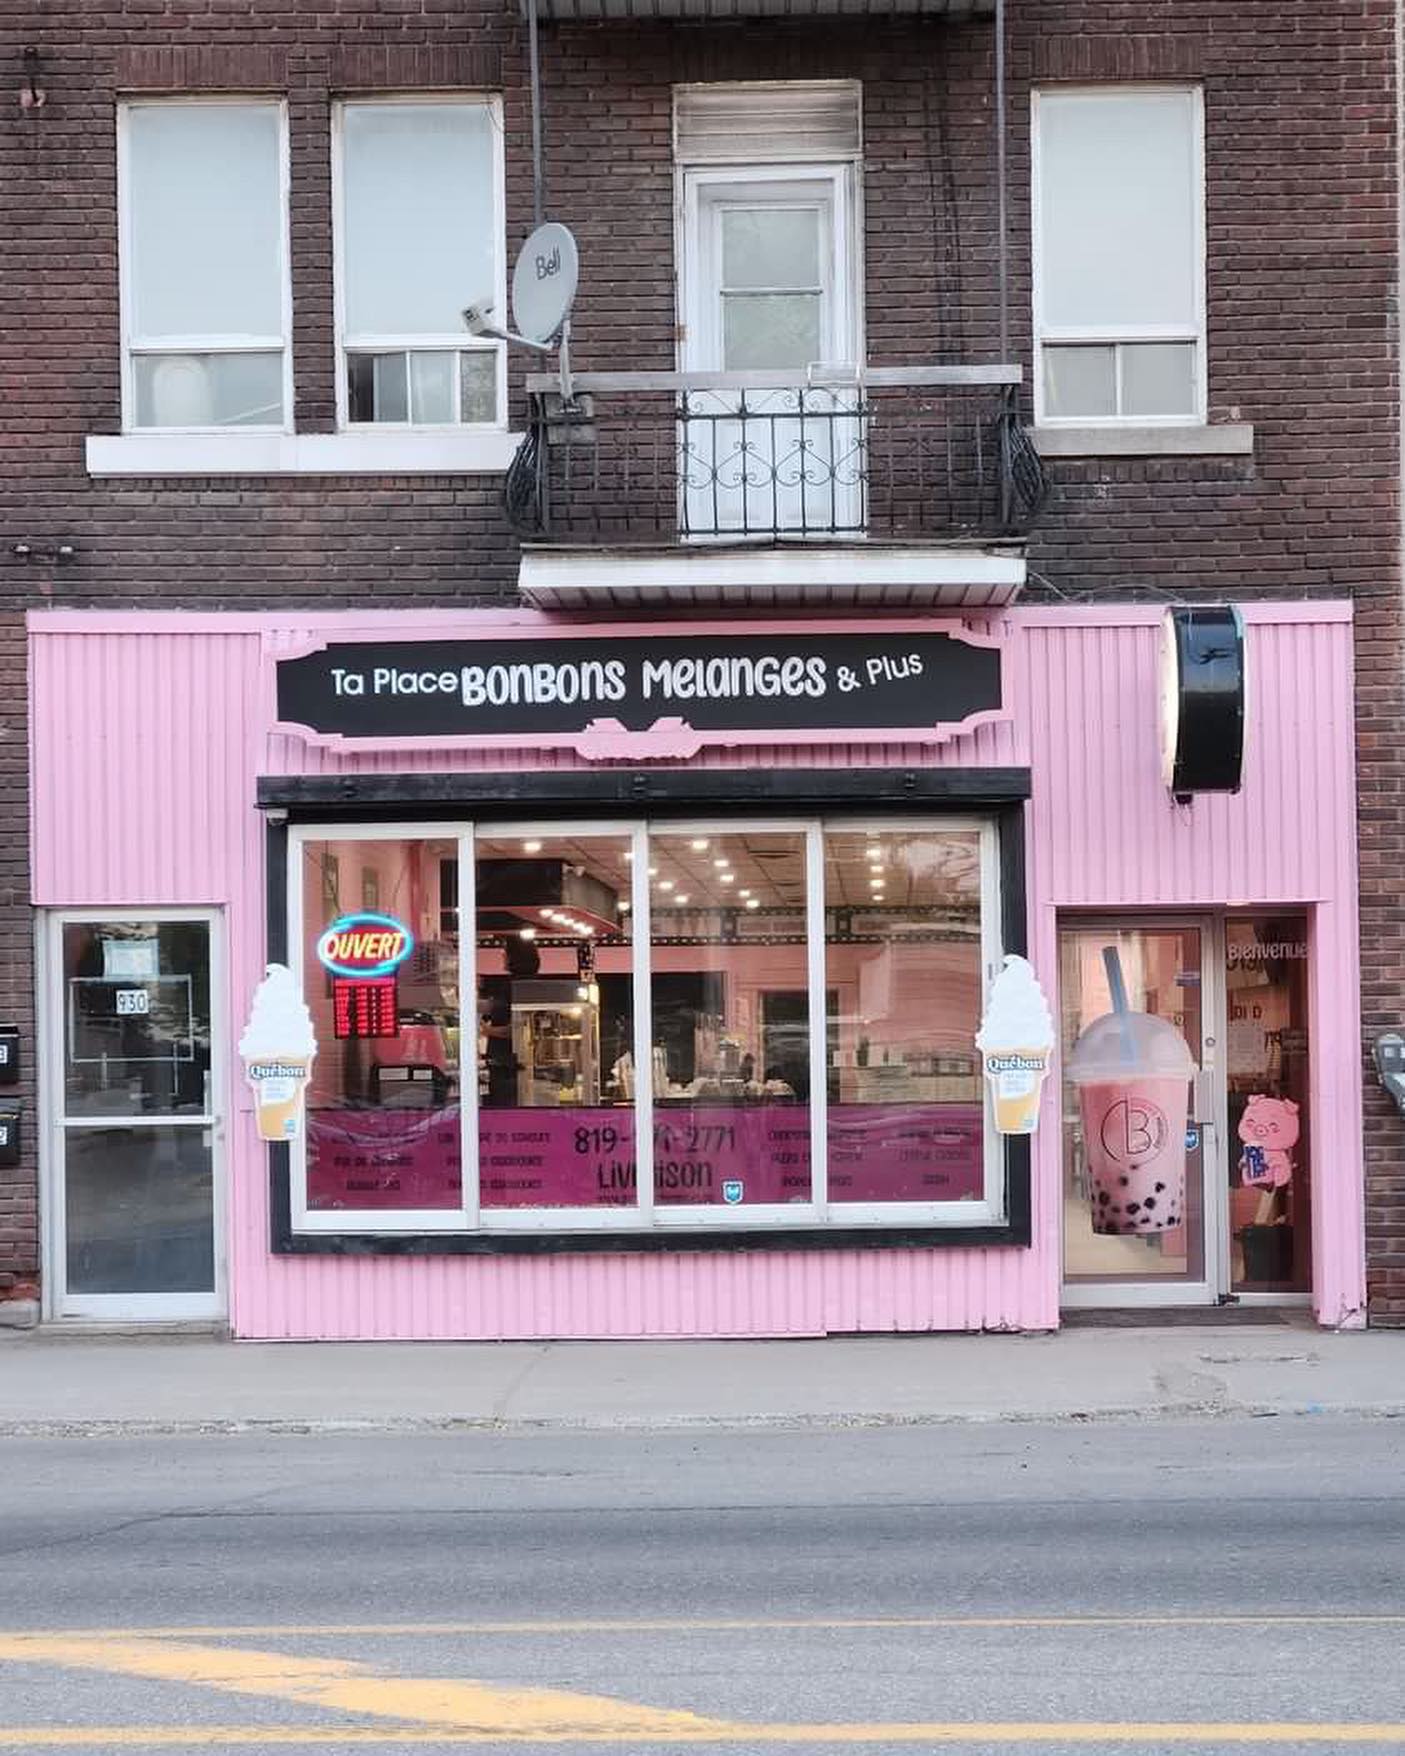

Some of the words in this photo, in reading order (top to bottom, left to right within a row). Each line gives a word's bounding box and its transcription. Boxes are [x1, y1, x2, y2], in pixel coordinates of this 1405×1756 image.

[536, 245, 561, 280] Bell
[331, 669, 364, 695] Ta
[373, 668, 458, 694] Place
[837, 665, 861, 692] &
[866, 653, 923, 685] Plus
[325, 932, 403, 960] OUVERT
[119, 994, 145, 1012] 930
[574, 1126, 736, 1154] 819-71-2771
